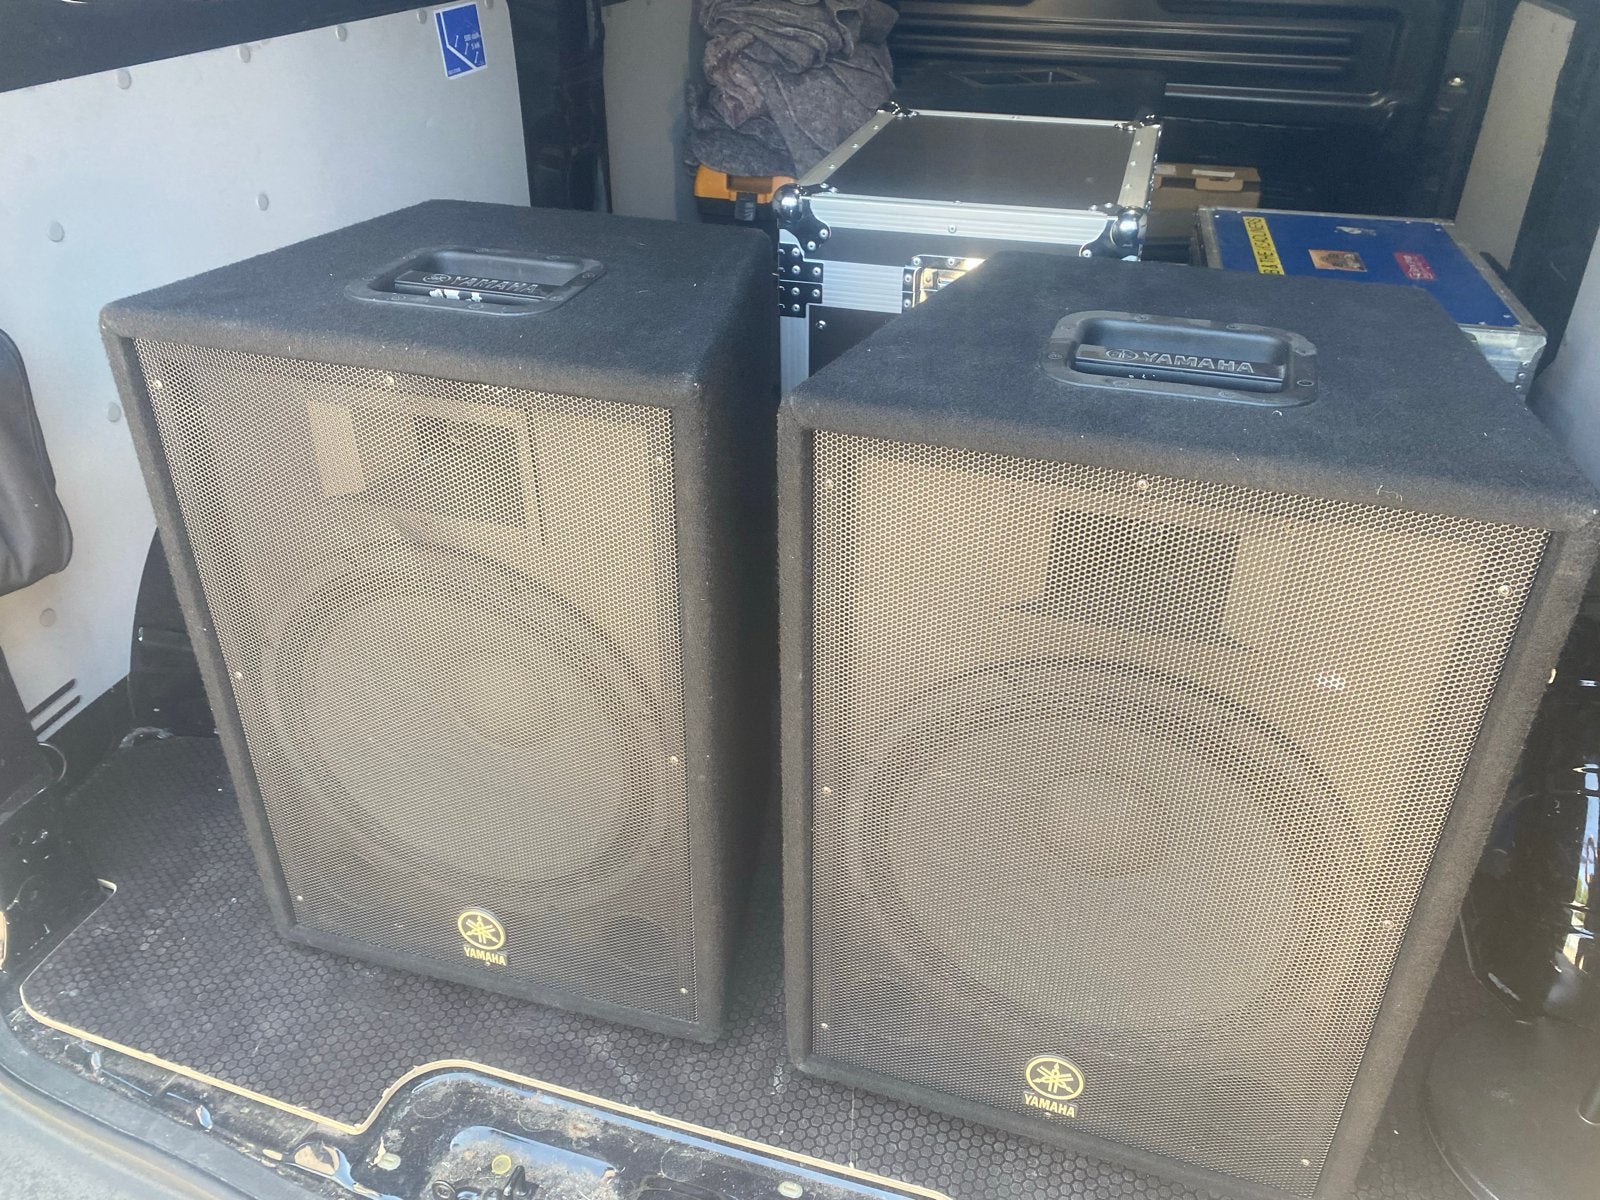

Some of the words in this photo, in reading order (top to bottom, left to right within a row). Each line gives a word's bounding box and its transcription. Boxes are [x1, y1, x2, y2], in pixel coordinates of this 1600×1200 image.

[451, 275, 539, 294] YAMAHA
[1142, 351, 1255, 374] YAMAHA
[463, 946, 507, 966] YAMAHA
[1024, 1093, 1076, 1118] YAMAHA
